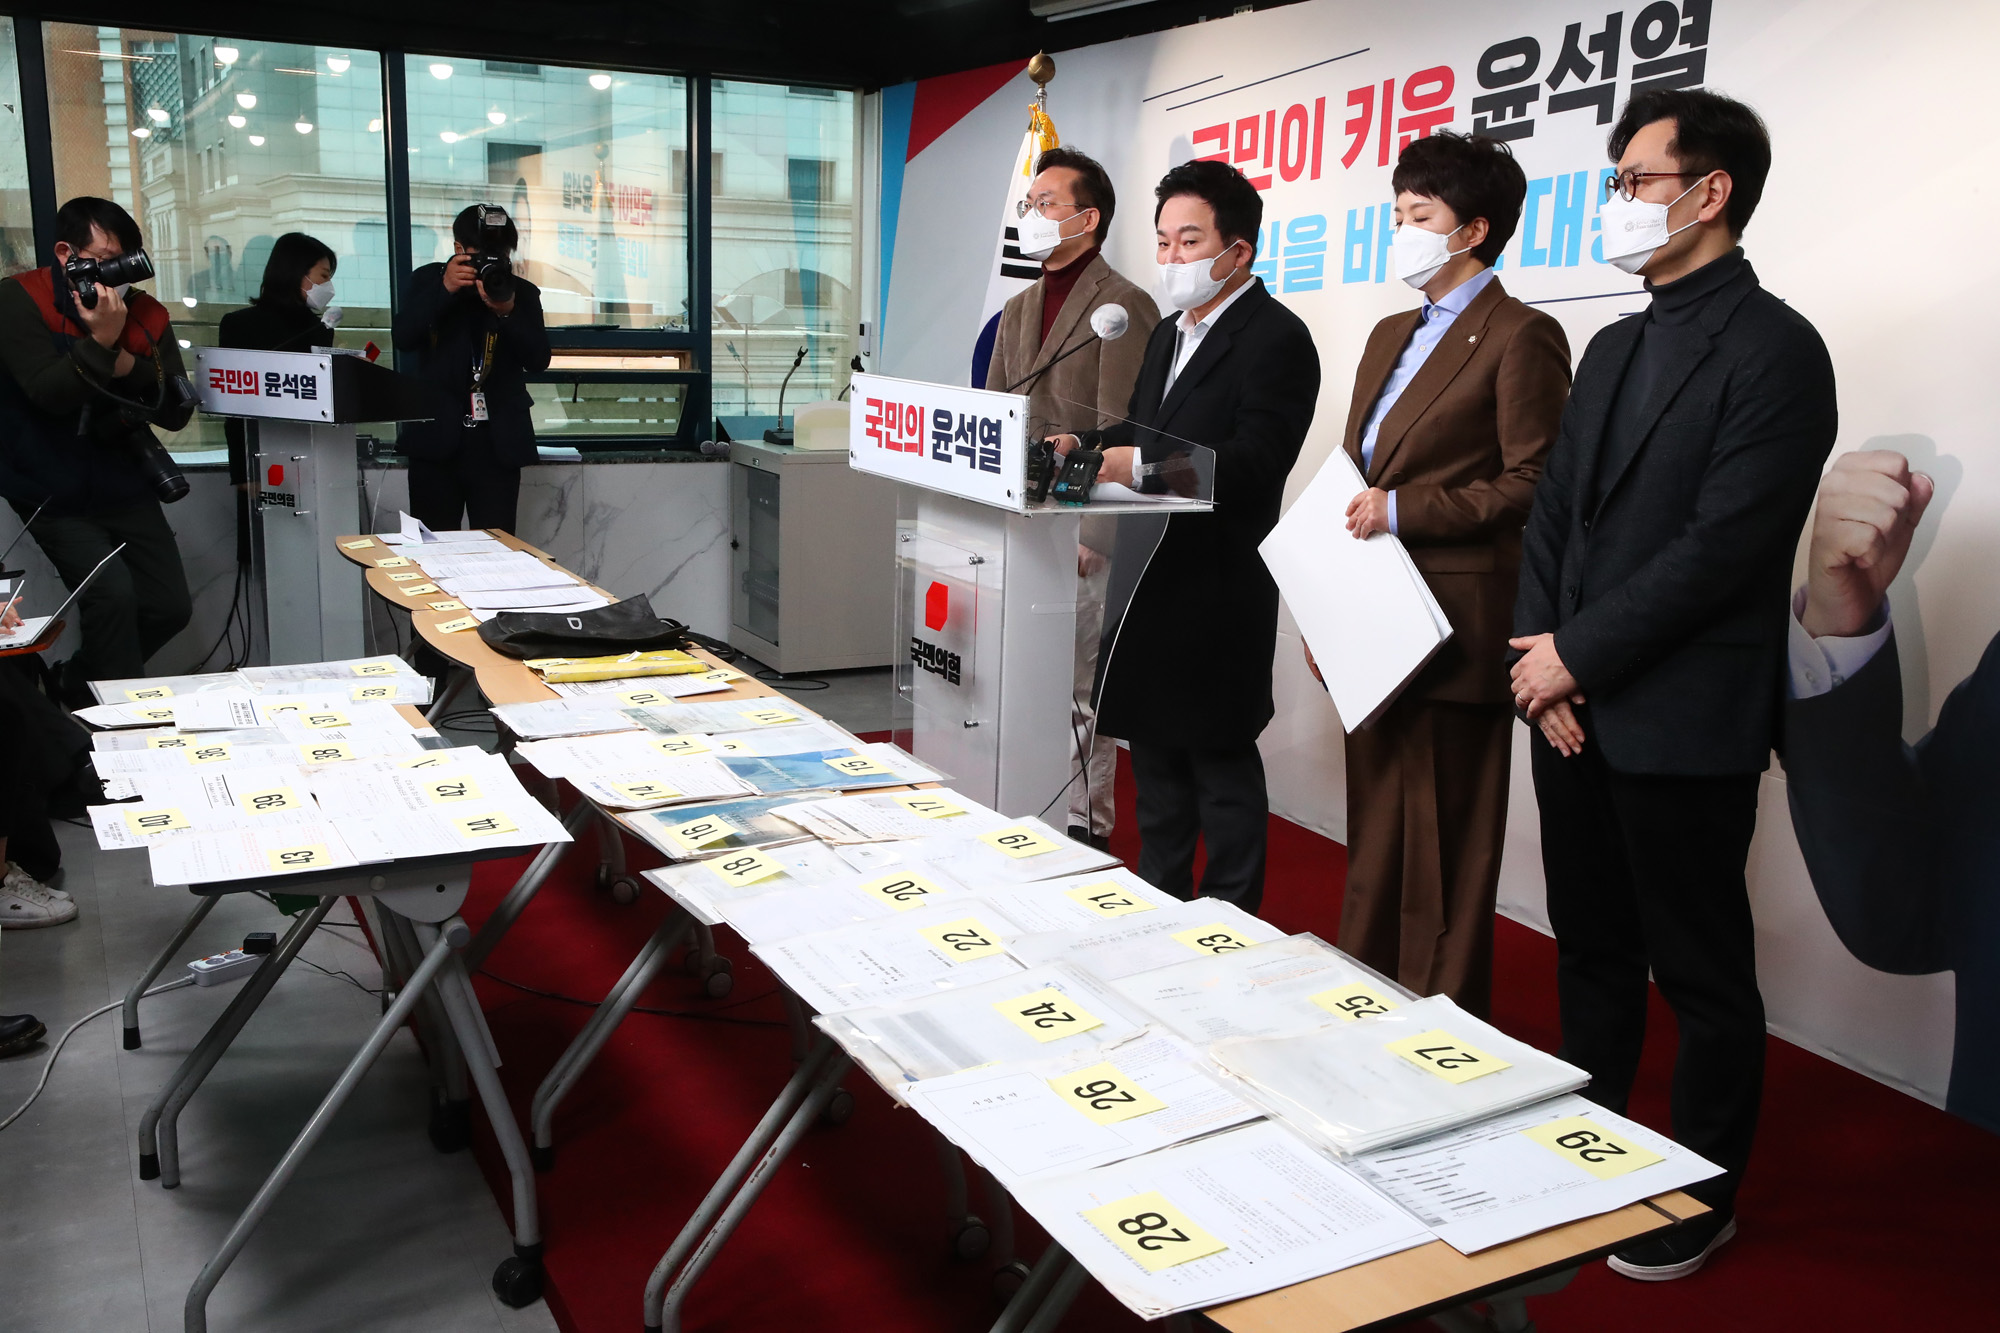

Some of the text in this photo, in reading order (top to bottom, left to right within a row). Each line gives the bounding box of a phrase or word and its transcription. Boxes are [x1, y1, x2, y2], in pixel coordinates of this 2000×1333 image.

[1471, 0, 1711, 143] 윤석열
[209, 368, 317, 400] 국민의 윤석열
[865, 397, 1002, 475] 국민의 윤석열
[258, 491, 295, 508] 국민의힘
[910, 637, 961, 686] 국민의힘
[363, 665, 386, 674] 31
[706, 673, 729, 682] 9
[135, 690, 164, 699] 30
[362, 688, 387, 697] 33
[630, 693, 659, 705] 10
[310, 714, 338, 725] 37
[757, 712, 783, 721] 11
[158, 738, 187, 748] 34
[662, 741, 693, 752] 12
[196, 749, 225, 759] 36
[313, 749, 341, 759] 38
[840, 760, 874, 772] 15
[436, 783, 466, 796] 42
[628, 785, 662, 796] 14
[253, 795, 285, 809] 39
[907, 801, 945, 812] 17
[138, 814, 173, 828] 40
[467, 819, 499, 830] 44
[681, 823, 718, 840] 16
[998, 835, 1035, 849] 19
[281, 851, 314, 864] 43
[724, 858, 761, 875] 18
[883, 881, 927, 900] 20
[1089, 893, 1132, 909] 21
[943, 930, 990, 950] 22
[1197, 935, 1245, 953] 23
[1336, 996, 1388, 1018] 25
[1021, 1003, 1075, 1028] 24
[1415, 1047, 1479, 1068] 27
[1074, 1081, 1136, 1109] 26
[1556, 1131, 1627, 1162] 29
[1118, 1213, 1190, 1250] 28
